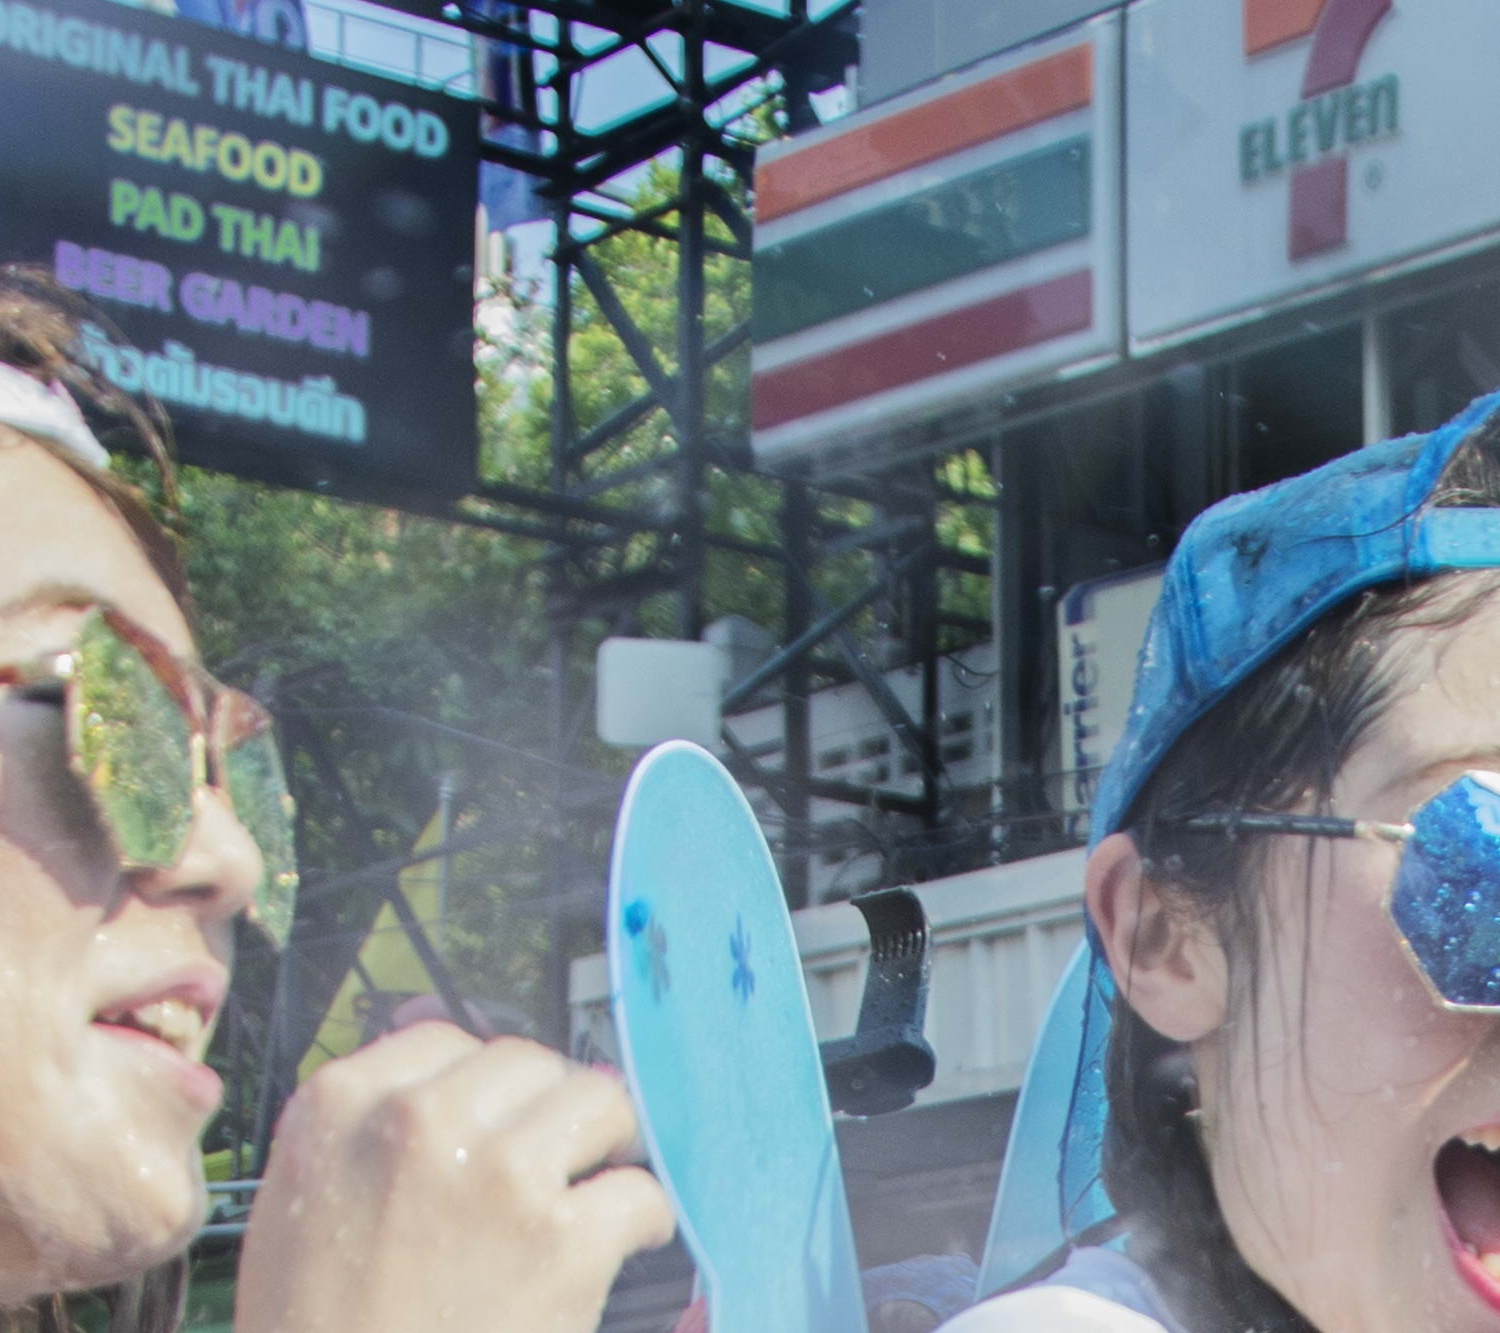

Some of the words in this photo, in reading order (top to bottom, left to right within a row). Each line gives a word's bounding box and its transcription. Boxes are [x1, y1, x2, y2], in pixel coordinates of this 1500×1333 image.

[109, 104, 323, 198] SEAFOOD
[206, 54, 315, 126] THAI
[323, 88, 449, 158] FOOD
[110, 179, 203, 244] PAD
[213, 206, 321, 274] THAI
[54, 240, 175, 313] BEER
[180, 272, 372, 359] GARDEN
